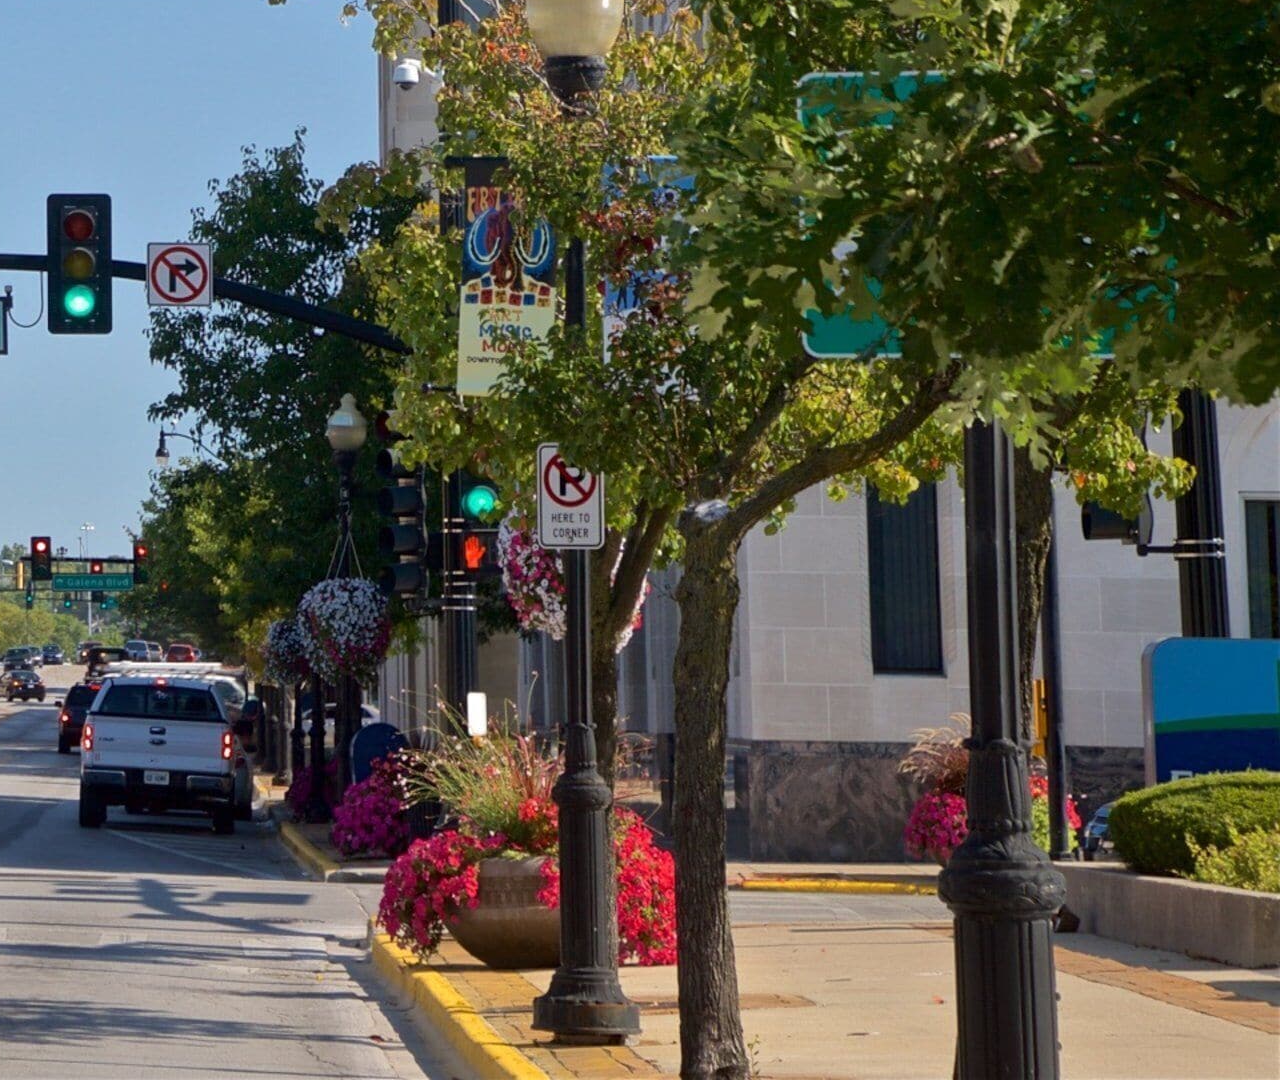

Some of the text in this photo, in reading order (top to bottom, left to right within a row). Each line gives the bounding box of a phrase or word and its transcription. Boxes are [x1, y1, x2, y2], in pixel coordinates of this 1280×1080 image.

[551, 513, 590, 523] HERE TO
[552, 528, 589, 538] CORNER
[67, 577, 129, 586] Galena Blvd
